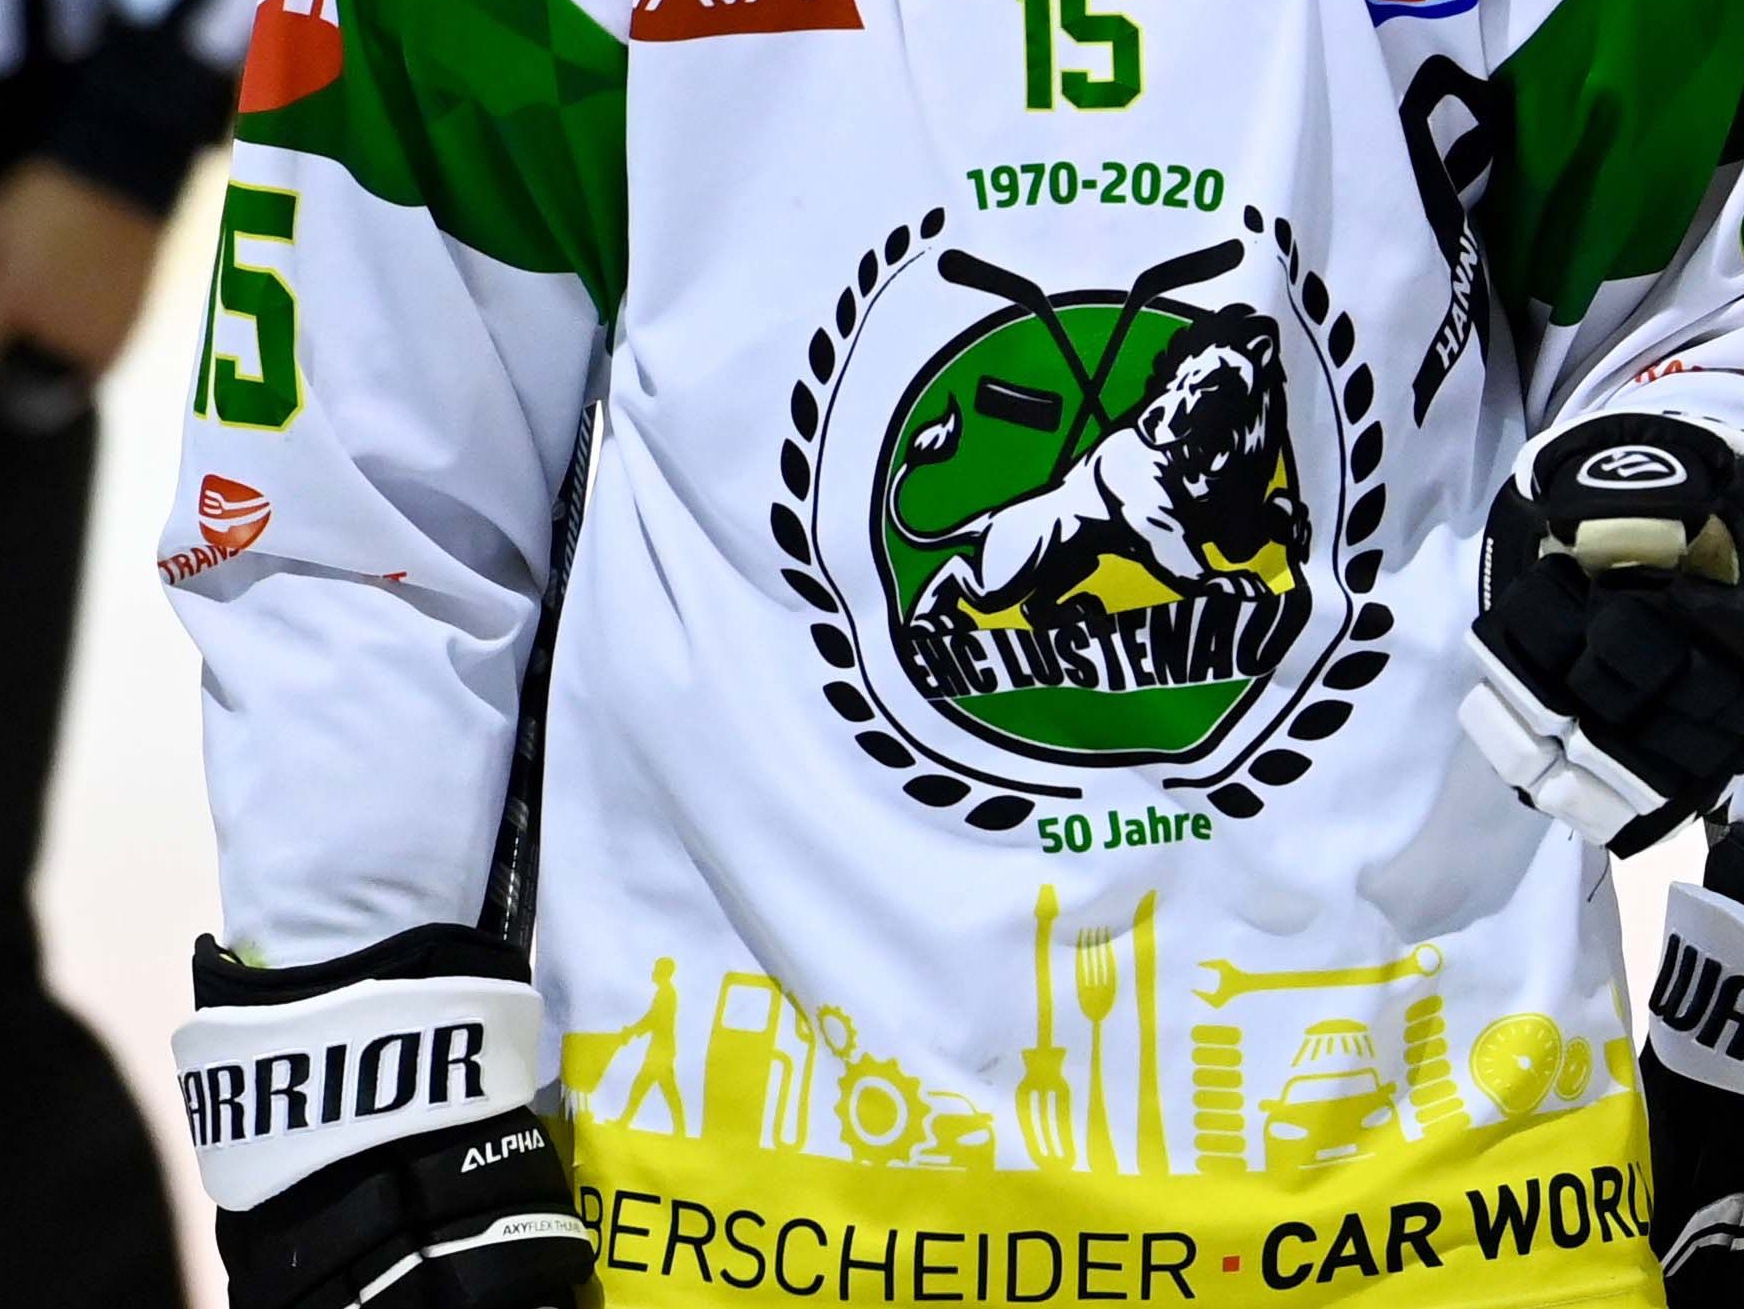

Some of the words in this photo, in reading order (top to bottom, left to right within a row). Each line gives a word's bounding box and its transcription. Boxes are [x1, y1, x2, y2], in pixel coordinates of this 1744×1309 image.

[965, 160, 1226, 213] 1970-2020
[909, 628, 999, 700] EHC
[997, 593, 1308, 692] LUSTENAU
[1037, 813, 1093, 855] 50
[1103, 805, 1213, 850] Jahre
[177, 1019, 487, 1148] ARRIOR
[459, 1126, 546, 1174] ALPHA
[1260, 1199, 1443, 1292] CAR
[1465, 1160, 1654, 1263] WORL
